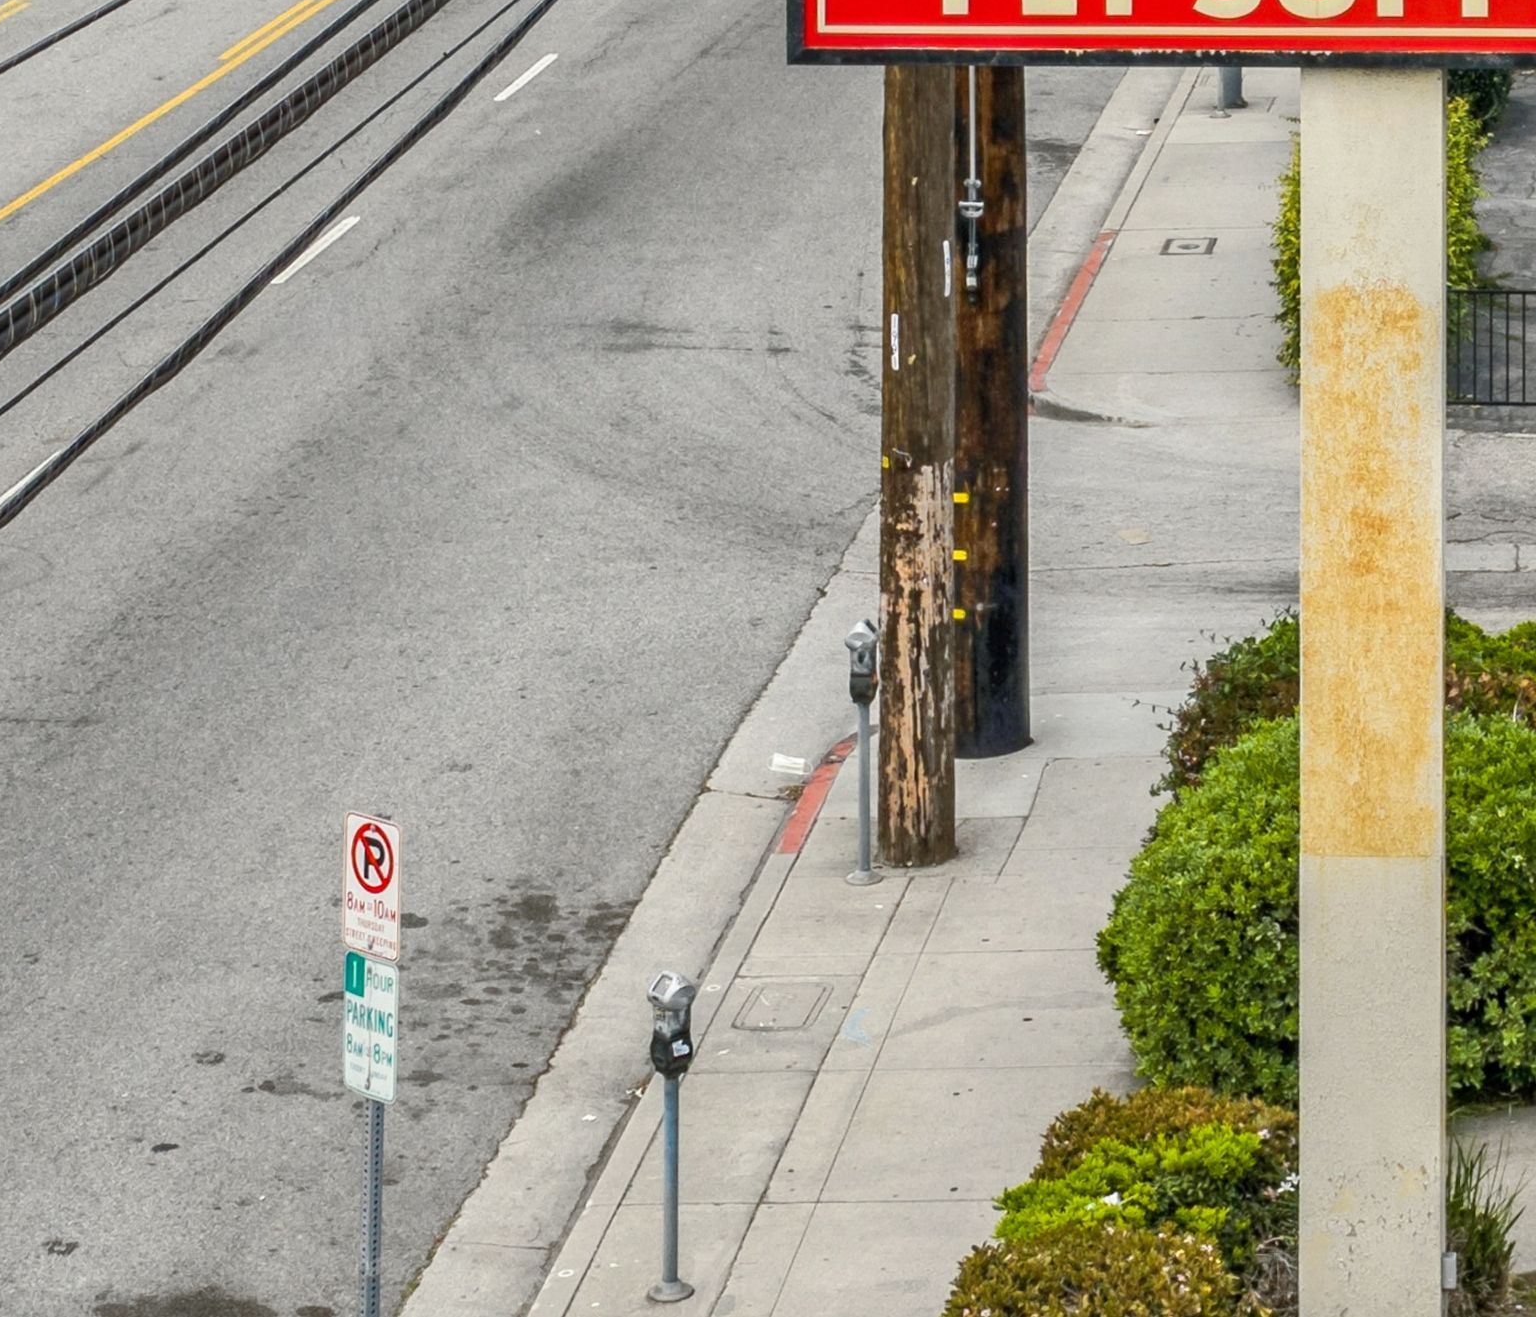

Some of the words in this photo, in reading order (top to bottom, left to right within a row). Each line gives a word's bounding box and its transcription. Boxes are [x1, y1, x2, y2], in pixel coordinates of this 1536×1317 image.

[347, 891, 366, 913] 8AM
[373, 899, 397, 923] 10AM
[345, 927, 366, 943] STREET
[366, 966, 394, 994] HOUR
[347, 999, 394, 1038] PARKING
[346, 1032, 364, 1057] 8AM
[373, 1042, 393, 1067] 8PM
